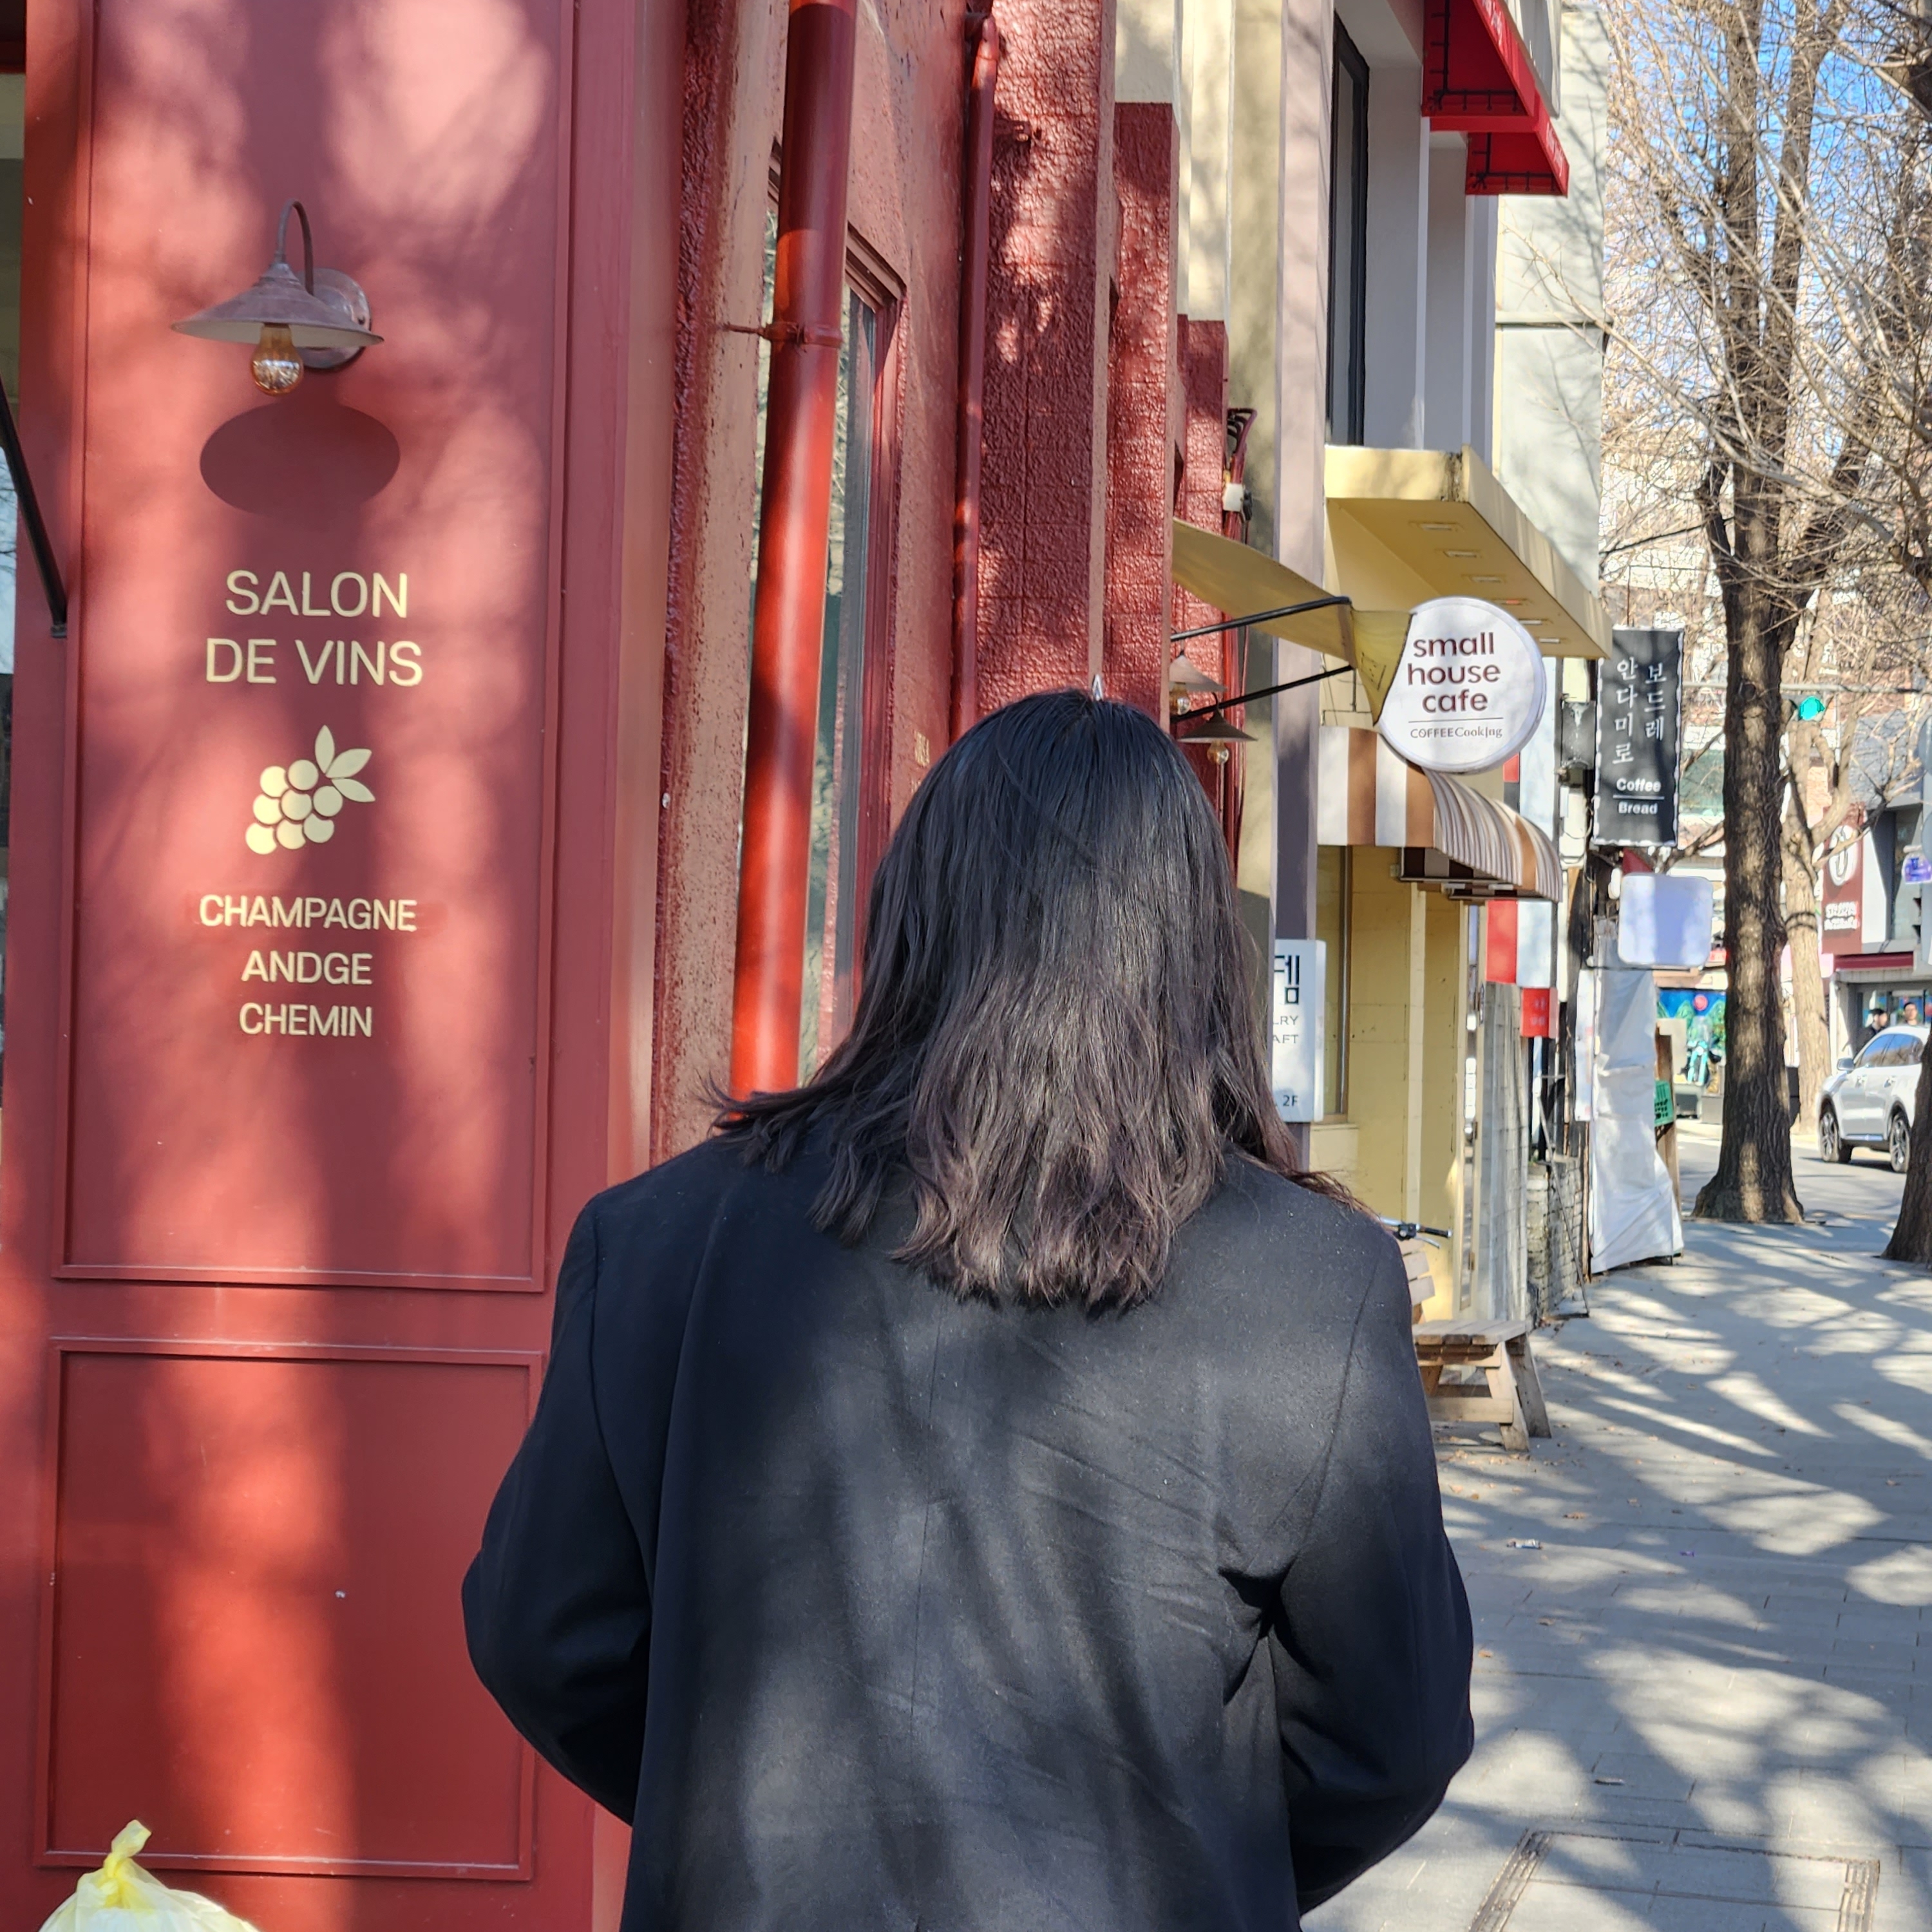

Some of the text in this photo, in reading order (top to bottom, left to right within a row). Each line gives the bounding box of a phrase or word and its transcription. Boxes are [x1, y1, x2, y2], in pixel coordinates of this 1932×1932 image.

[226, 571, 408, 618] SALON
[1413, 632, 1494, 658] small
[206, 638, 423, 687] DE VINS
[1408, 663, 1501, 685] house
[1422, 689, 1488, 714] cafe
[1612, 656, 1638, 764] 안다미로
[1643, 662, 1667, 741] 보드레
[1616, 778, 1661, 792] Coffee
[1618, 801, 1658, 815] Bread
[199, 895, 417, 932] CHAMPAGNE
[241, 951, 372, 985] ANDGE
[240, 1002, 372, 1037] CHEMIN
[1282, 1095, 1298, 1107] 2F
